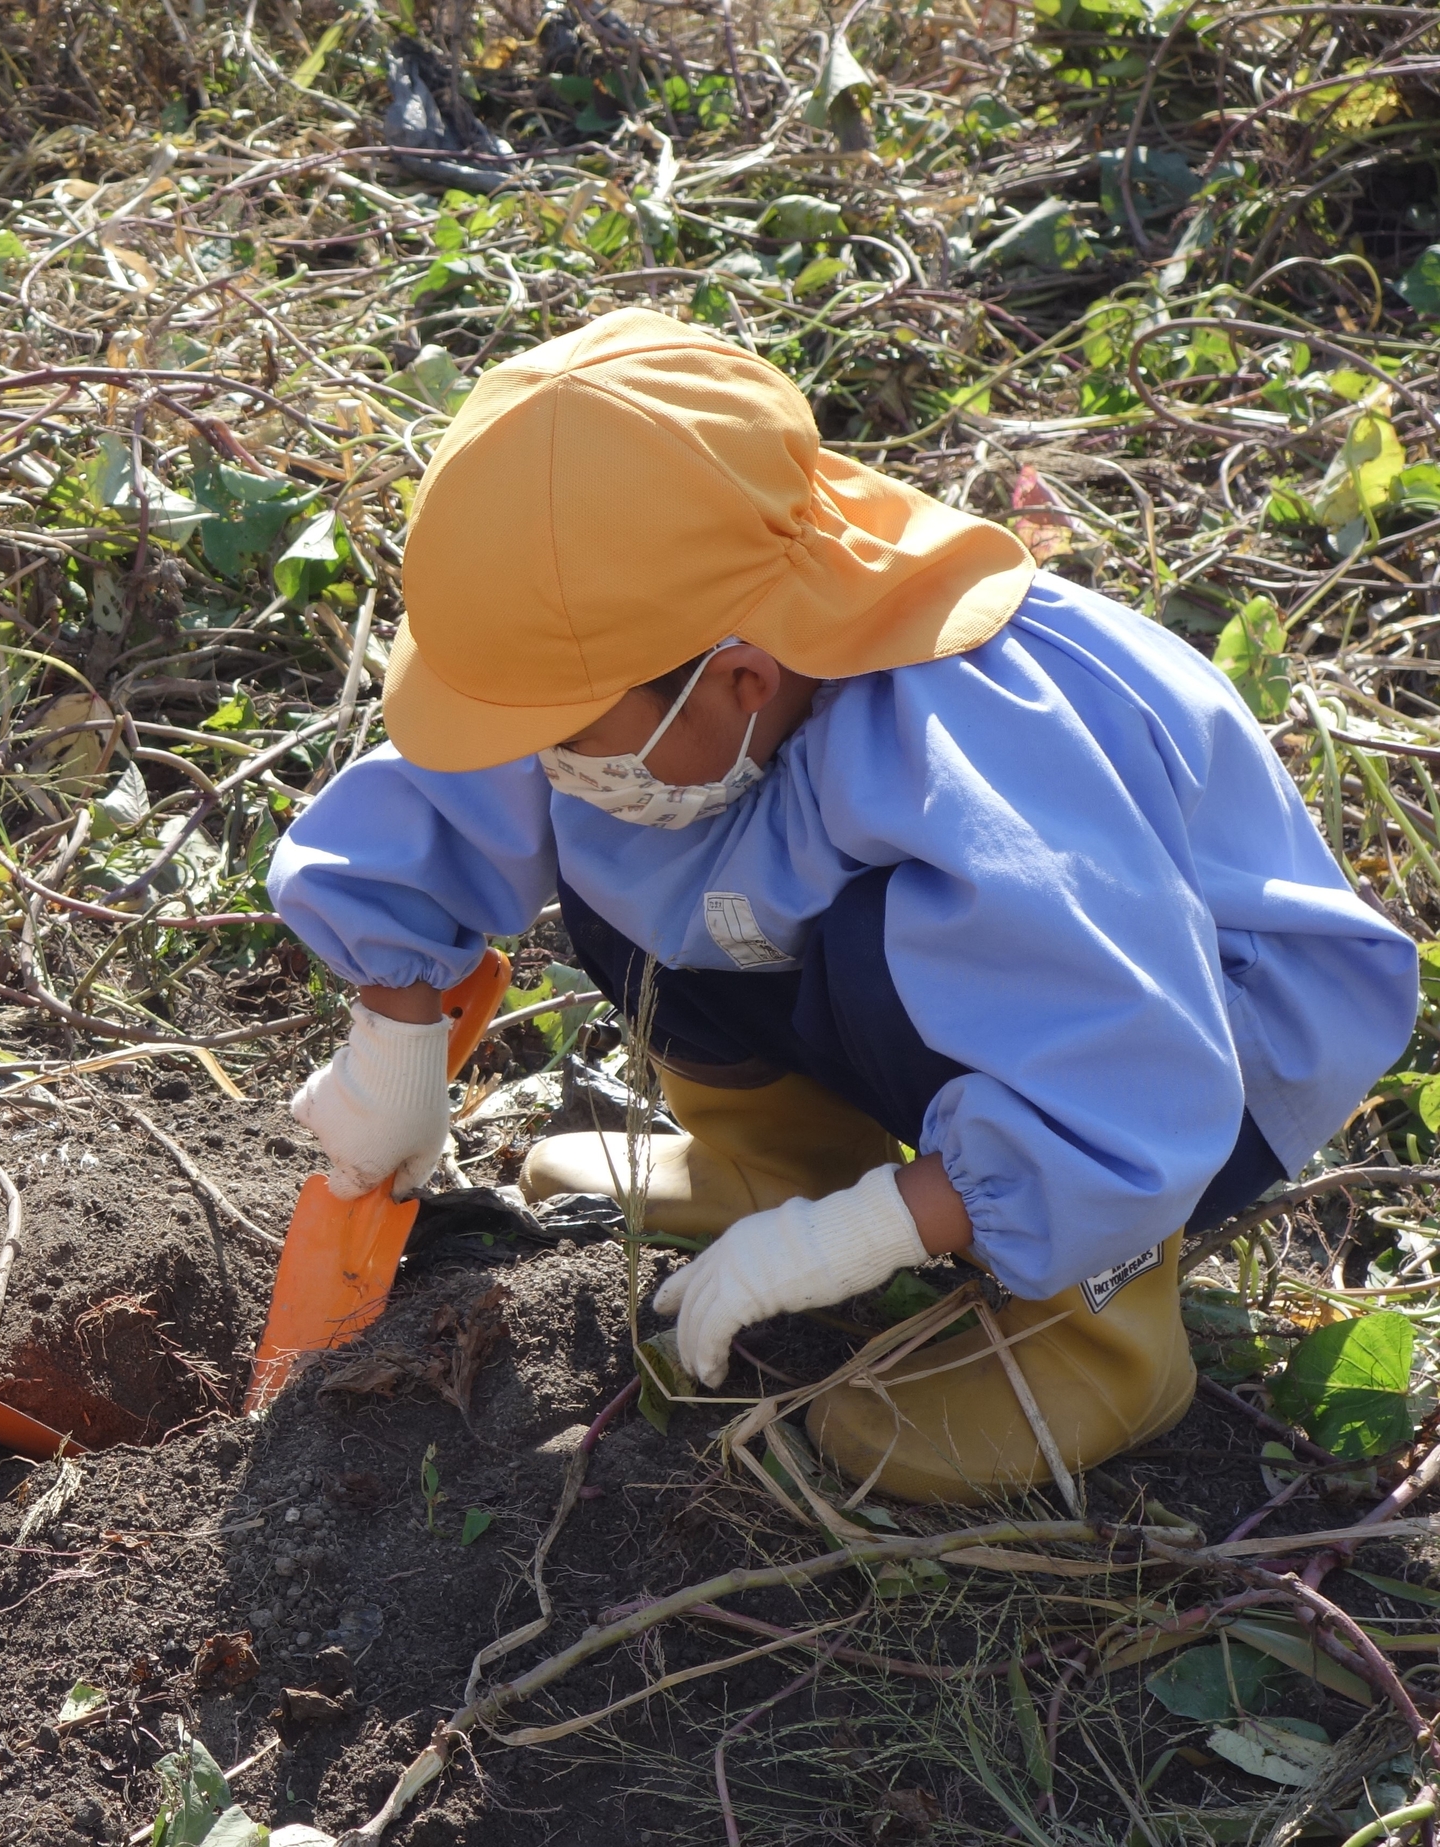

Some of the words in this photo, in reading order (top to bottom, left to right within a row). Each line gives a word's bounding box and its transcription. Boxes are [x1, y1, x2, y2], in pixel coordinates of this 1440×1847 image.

[1094, 1280, 1110, 1295] FACE
[1109, 1268, 1129, 1287] YOUR
[1128, 1249, 1153, 1273] FEARS
